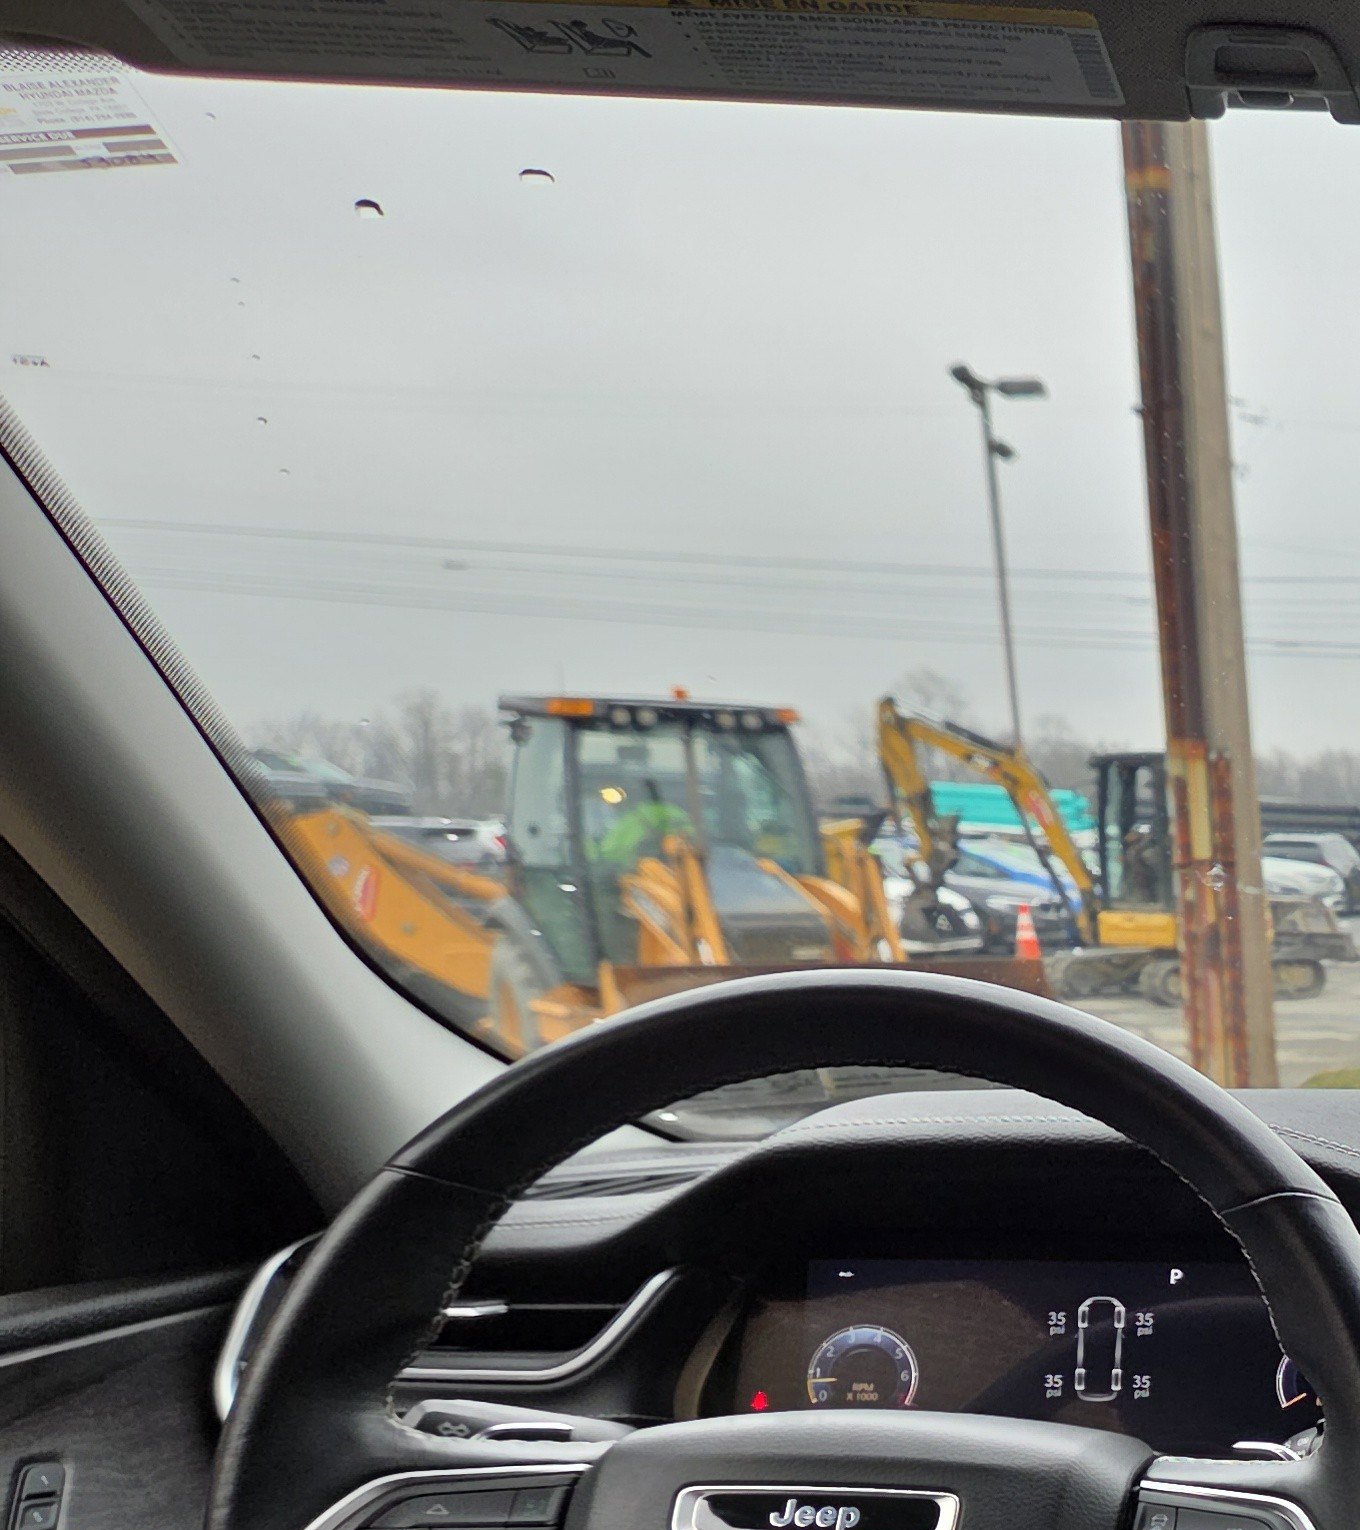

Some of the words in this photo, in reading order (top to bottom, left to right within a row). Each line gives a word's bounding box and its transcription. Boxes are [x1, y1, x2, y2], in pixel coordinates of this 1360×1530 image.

[1170, 1268, 1184, 1285] P
[1048, 1311, 1067, 1326] 35
[1135, 1312, 1155, 1327] 35
[826, 1346, 835, 1357] 2
[894, 1348, 903, 1359] 5
[816, 1367, 821, 1378] 1
[900, 1370, 910, 1381] 6
[1044, 1374, 1064, 1388] 35
[1133, 1375, 1152, 1389] 35
[819, 1390, 828, 1402] 0
